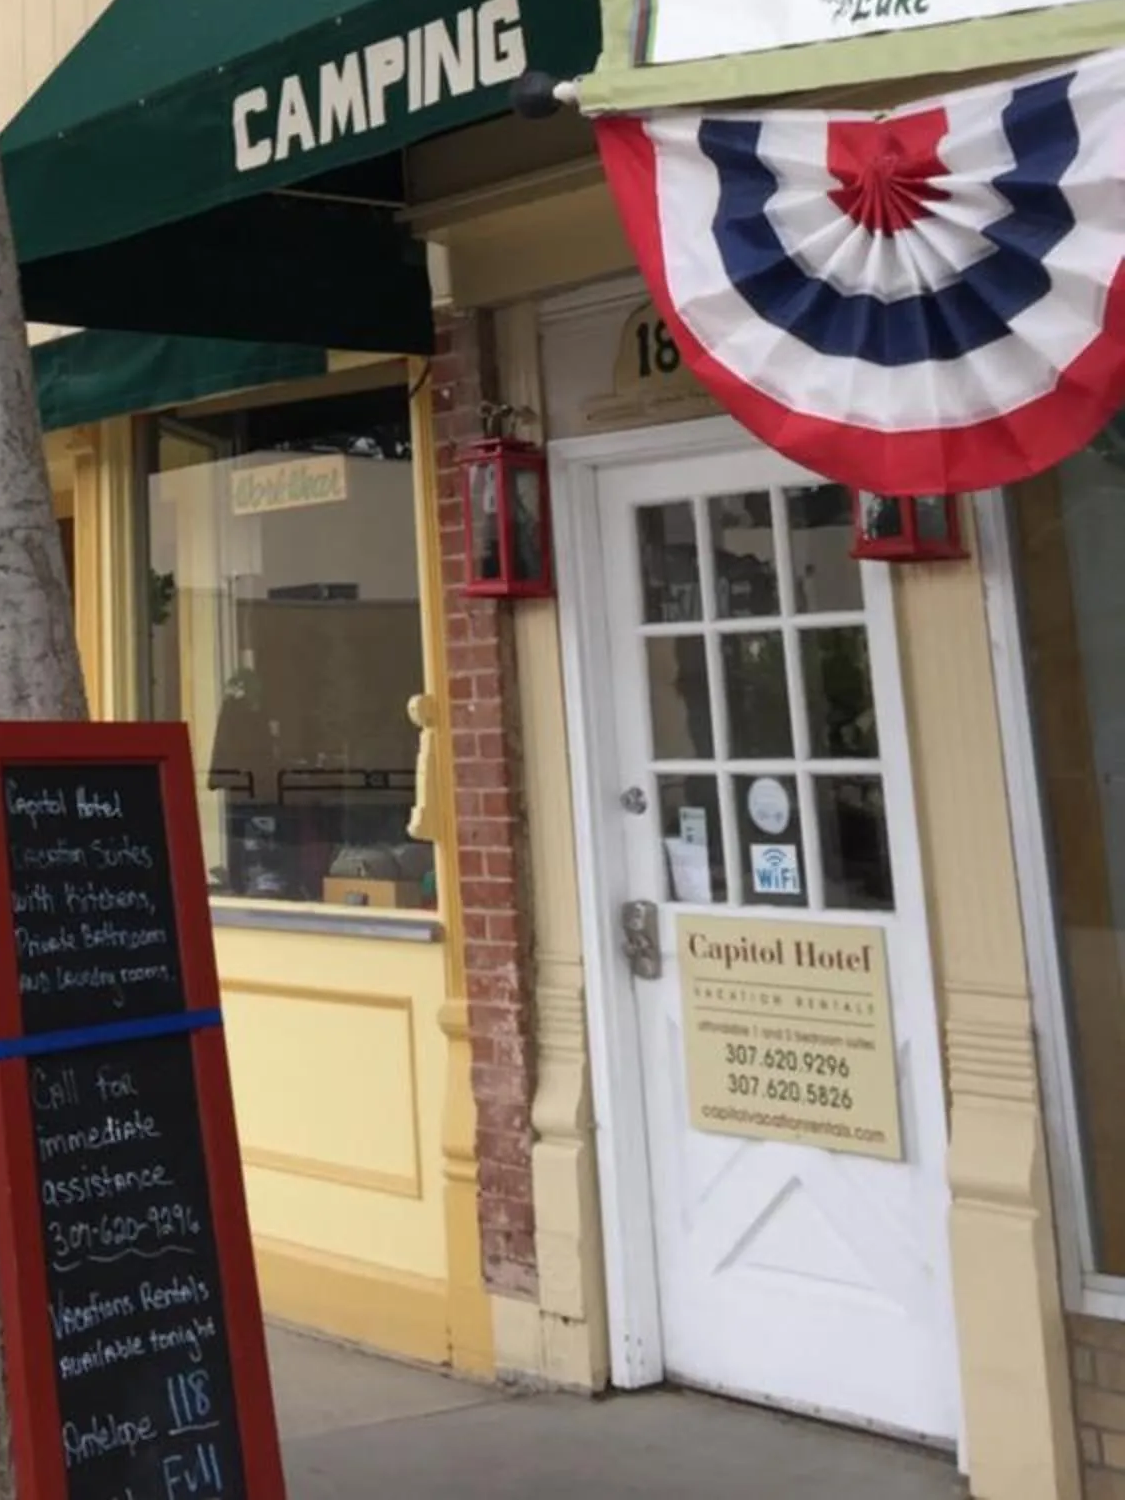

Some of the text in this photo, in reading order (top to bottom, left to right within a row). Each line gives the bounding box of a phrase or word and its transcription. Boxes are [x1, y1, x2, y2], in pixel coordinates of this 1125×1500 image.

[75, 784, 123, 818] Hotel
[90, 835, 153, 870] Suites
[757, 867, 798, 890] WiFi
[11, 883, 56, 913] with
[13, 925, 76, 958] Private
[688, 935, 874, 973] Capitol Hotel
[693, 986, 874, 1016] VACATION RENTALS
[725, 1043, 851, 1079] 307.620.9296
[727, 1072, 854, 1111] 307.620.5826
[41, 1165, 175, 1207] assistance
[140, 1274, 210, 1311] Rentals
[149, 1315, 216, 1363] tonight
[62, 1368, 212, 1468] Antelope 118
[163, 1443, 222, 1500] Full
